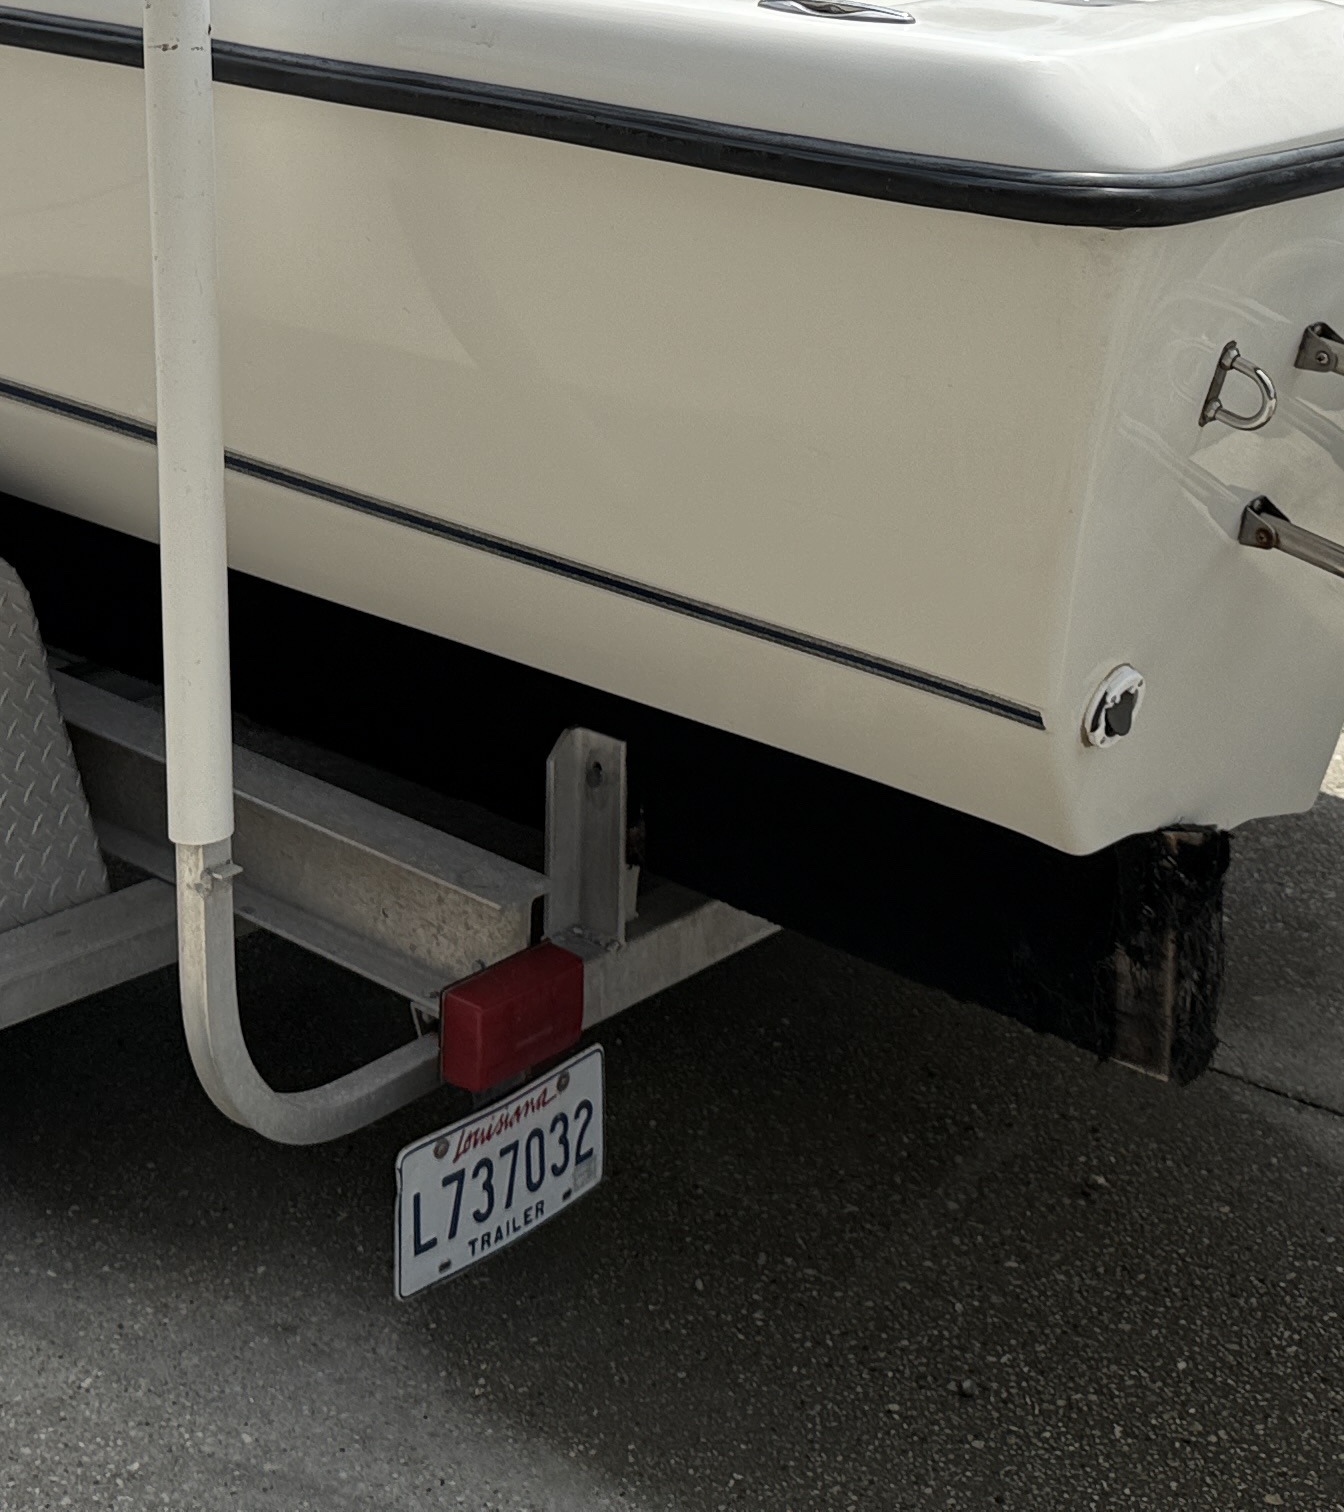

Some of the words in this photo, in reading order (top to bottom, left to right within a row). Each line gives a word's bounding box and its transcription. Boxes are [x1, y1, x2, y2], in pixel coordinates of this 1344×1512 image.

[453, 1088, 558, 1164] Louisiana
[413, 1098, 594, 1257] L737032
[468, 1199, 546, 1257] TRAILER
